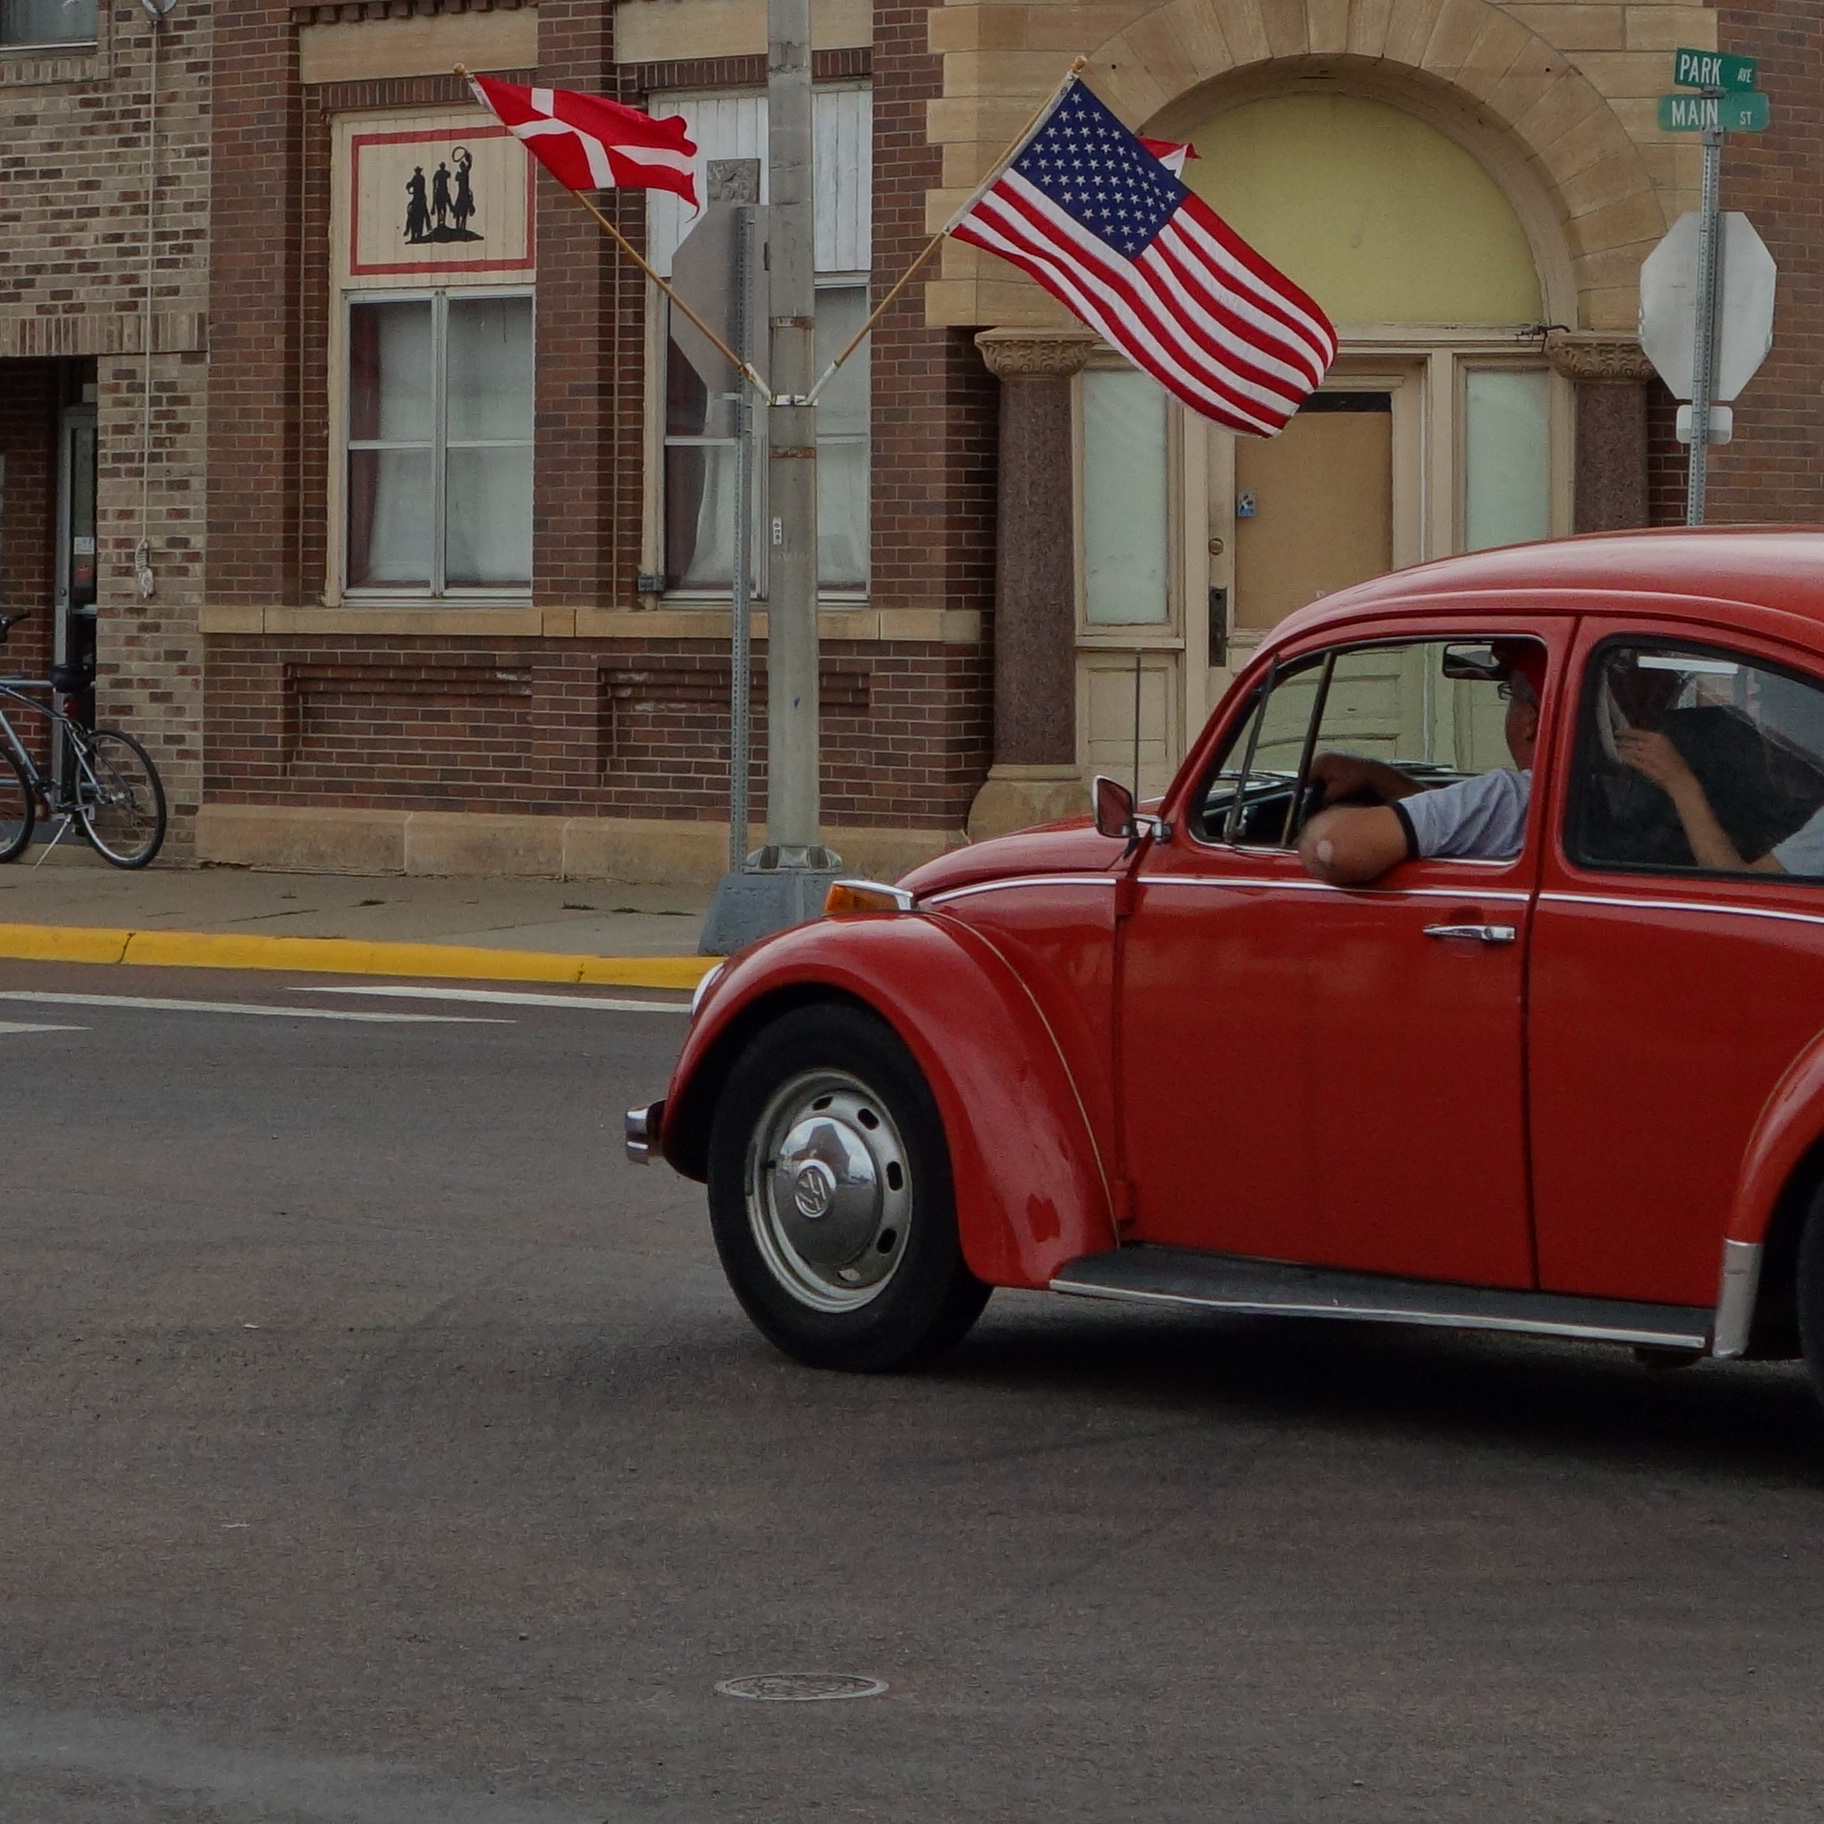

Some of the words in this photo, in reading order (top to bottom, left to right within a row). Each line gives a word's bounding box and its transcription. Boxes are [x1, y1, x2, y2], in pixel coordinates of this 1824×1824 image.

[1679, 54, 1723, 85] PARK
[1737, 67, 1753, 83] AVE
[1671, 98, 1719, 127] MAIN
[1739, 111, 1753, 125] ST
